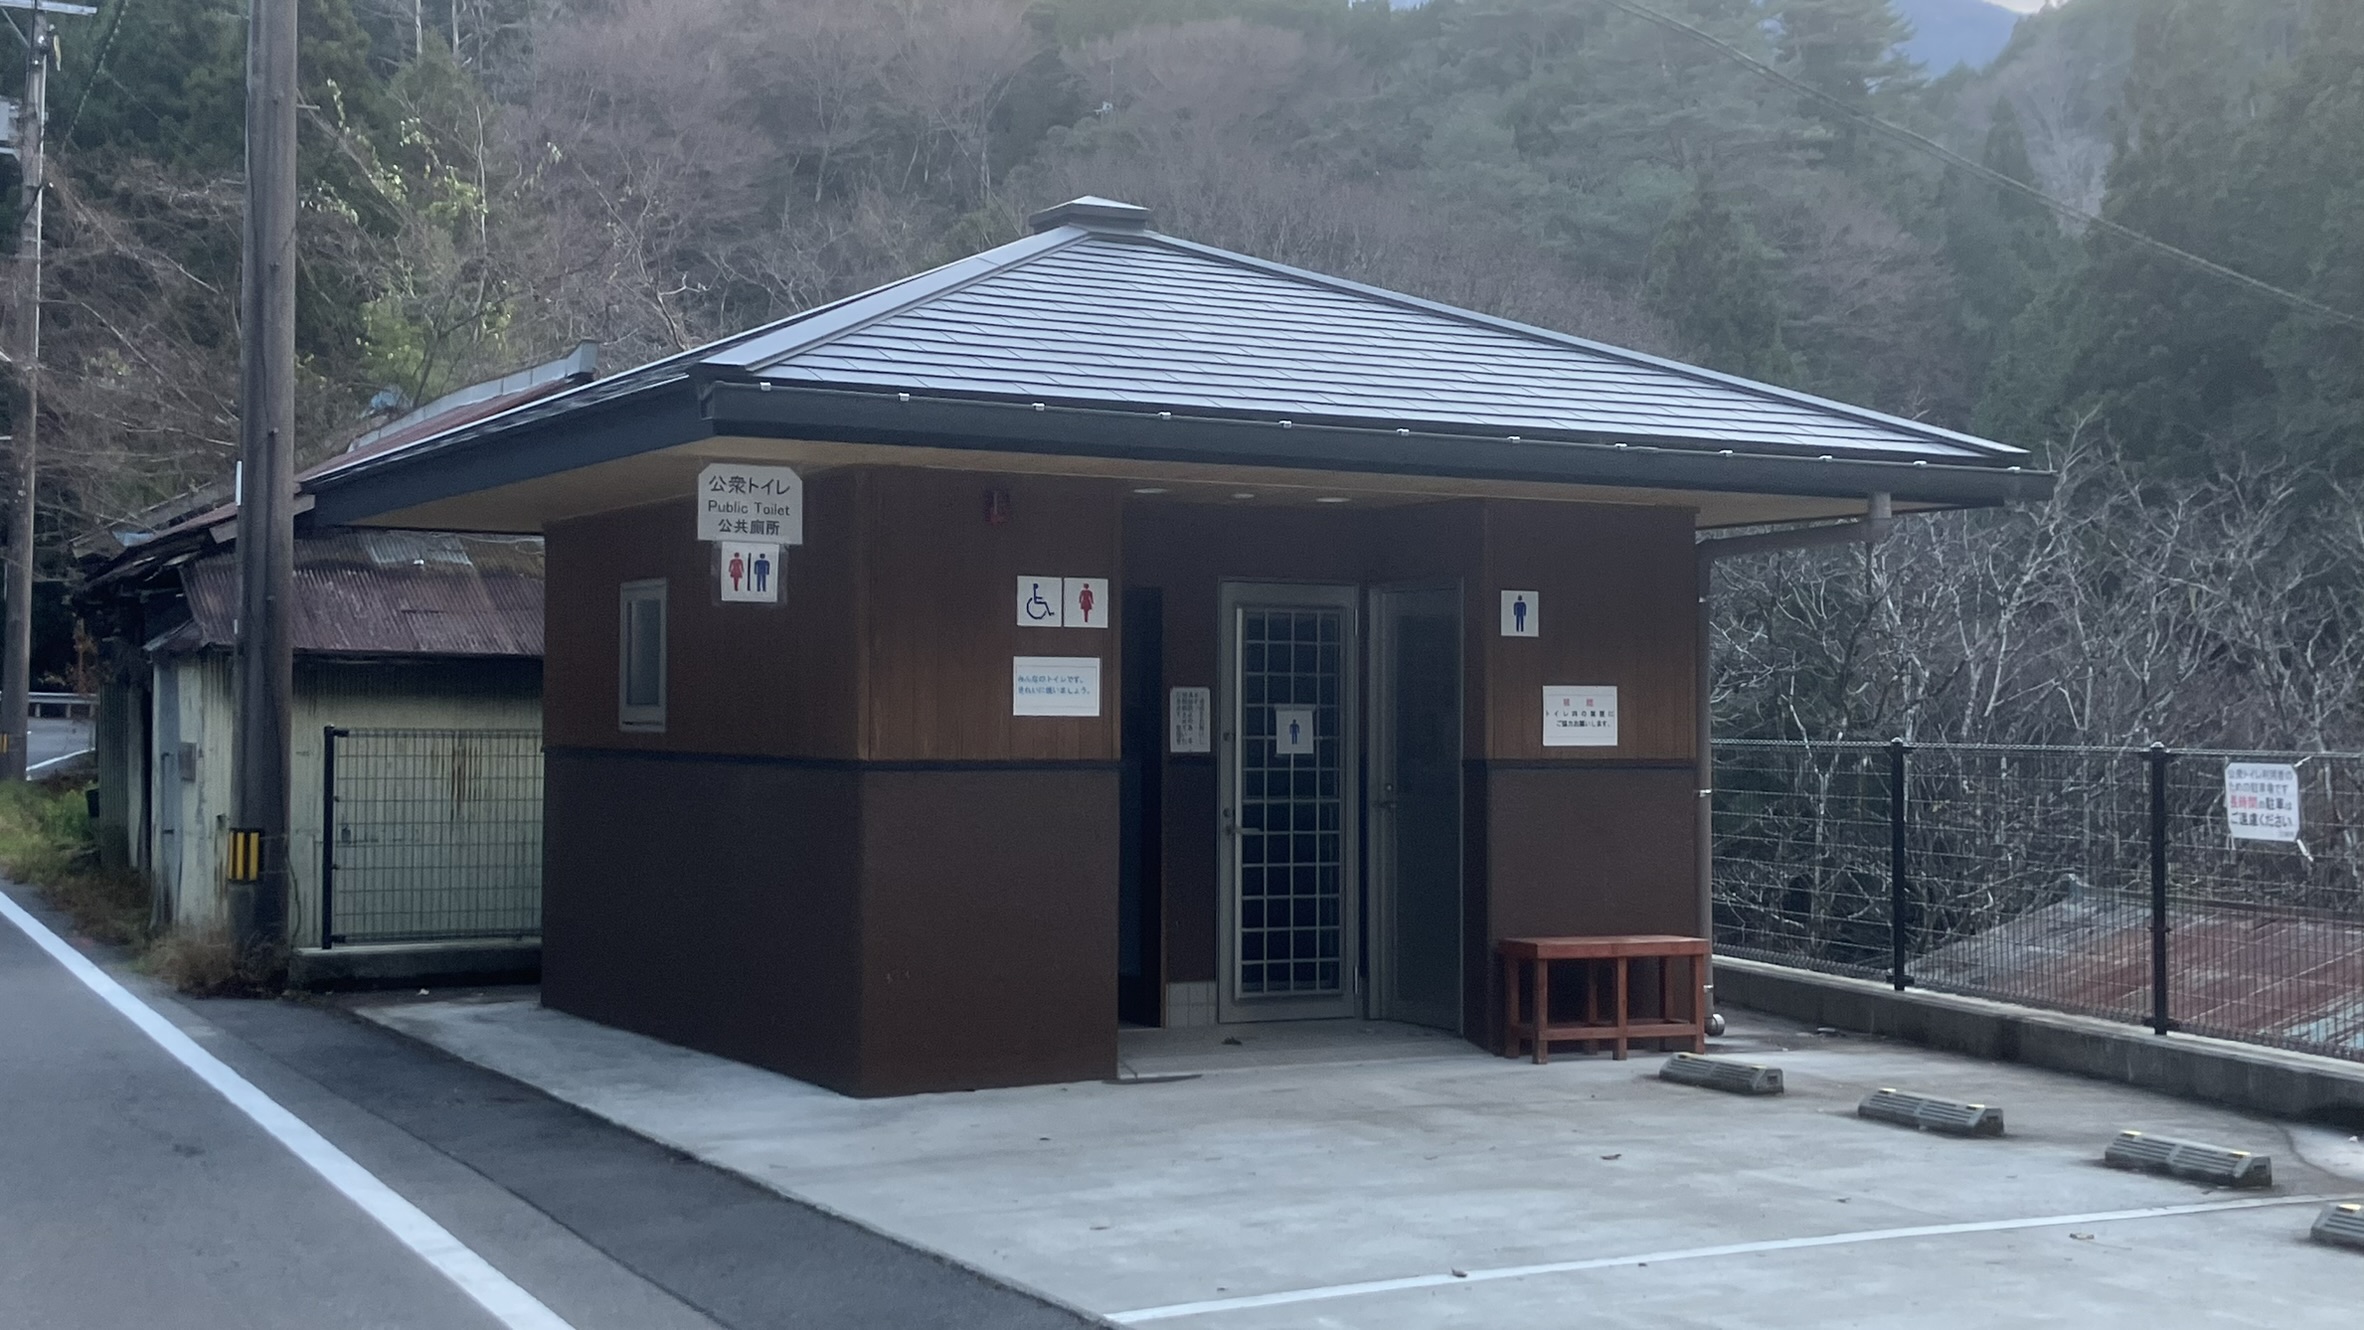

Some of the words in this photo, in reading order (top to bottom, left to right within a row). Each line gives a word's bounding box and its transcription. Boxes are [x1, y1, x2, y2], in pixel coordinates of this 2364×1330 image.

[708, 475, 791, 496] 公衆トイレ
[708, 499, 749, 514] Public
[753, 501, 791, 516] Toilet
